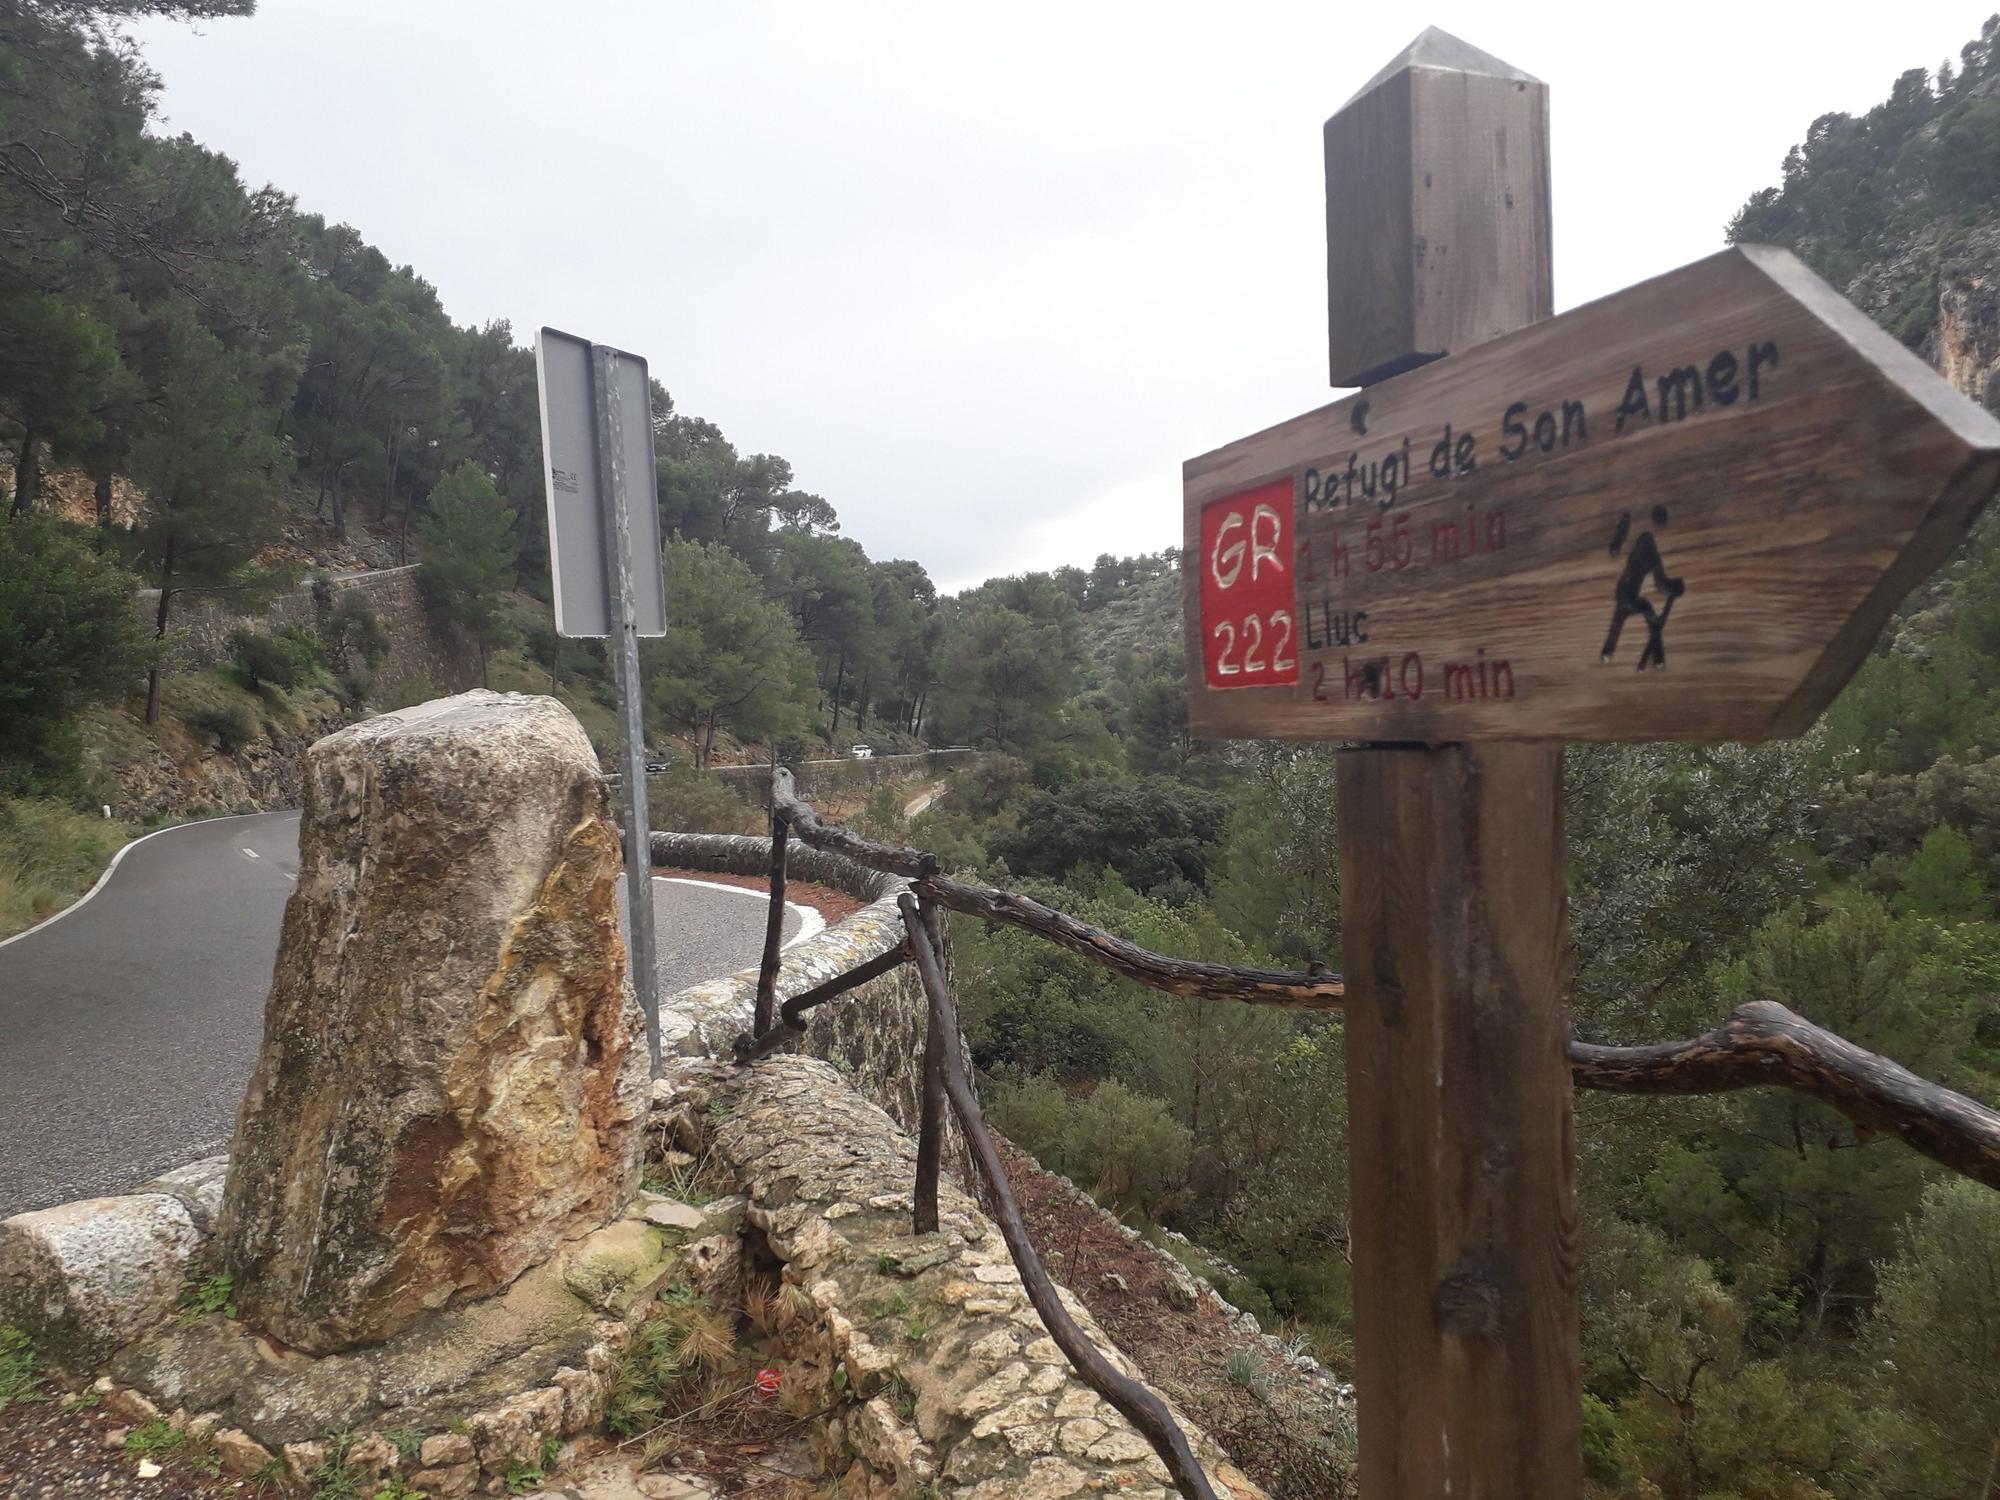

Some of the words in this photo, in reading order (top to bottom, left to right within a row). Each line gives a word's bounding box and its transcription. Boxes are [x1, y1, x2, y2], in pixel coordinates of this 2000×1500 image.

[1304, 437, 1410, 512] Refugi
[1430, 423, 1475, 478] de
[1500, 399, 1588, 463] Son
[1614, 340, 1779, 433] Amer
[1212, 504, 1284, 589] GR
[1302, 537, 1317, 582] 1
[1331, 529, 1349, 577] h
[1365, 513, 1412, 572] 55
[1431, 503, 1507, 561] min
[1214, 609, 1295, 675] 222
[1306, 601, 1369, 649] Lluc
[1308, 661, 1327, 701] 2
[1442, 648, 1515, 700] min
